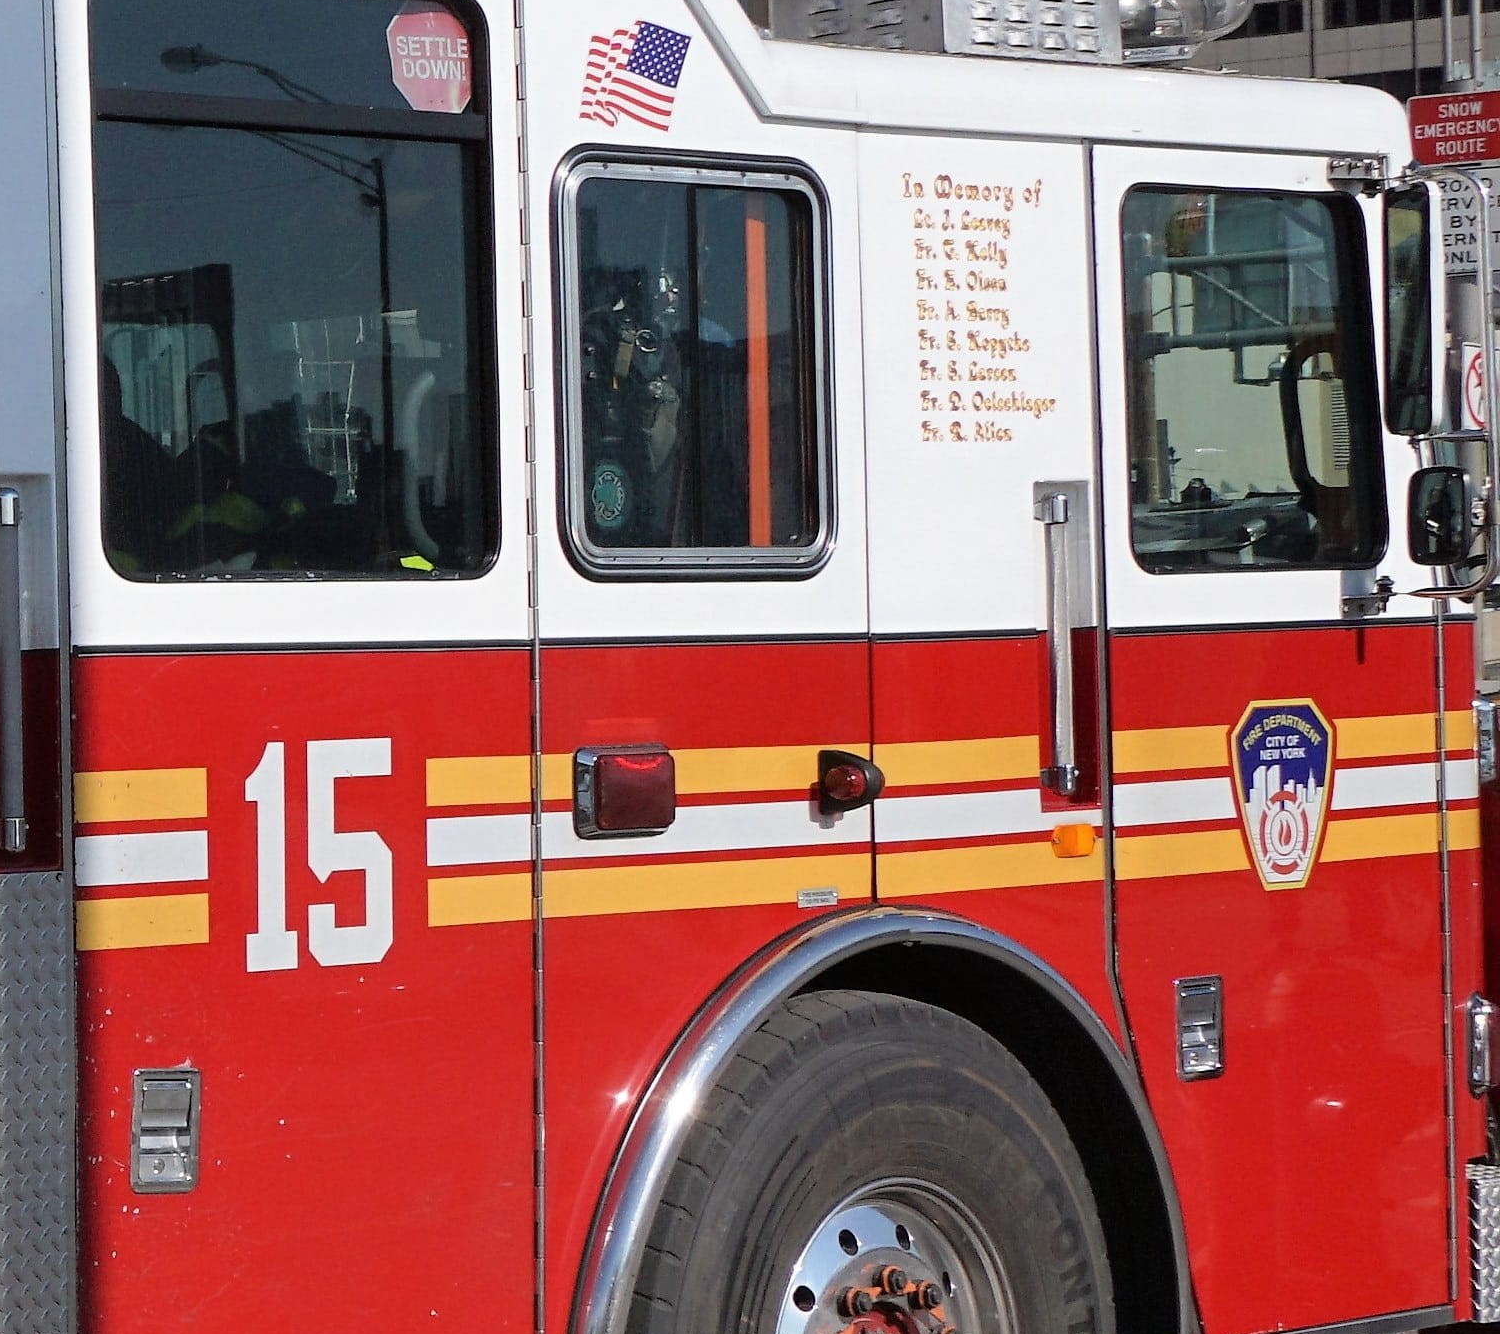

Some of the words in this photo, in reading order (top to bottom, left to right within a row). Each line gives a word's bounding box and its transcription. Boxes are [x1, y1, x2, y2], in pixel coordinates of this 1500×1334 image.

[396, 35, 469, 58] SETTLE
[402, 58, 467, 81] DOWN!
[1438, 101, 1483, 118] SNOW
[1435, 138, 1487, 156] ROUTE
[902, 173, 924, 198] In
[933, 174, 1014, 211] Memory
[1022, 179, 1042, 208] of
[1450, 216, 1477, 229] BY
[1242, 724, 1264, 751] FIRE
[1263, 714, 1322, 746] DEPARTMENT
[1266, 736, 1286, 747] CITY
[1286, 735, 1300, 746] OF
[1260, 749, 1280, 760] NEW
[1281, 748, 1306, 759] YORK
[243, 736, 395, 973] 15
